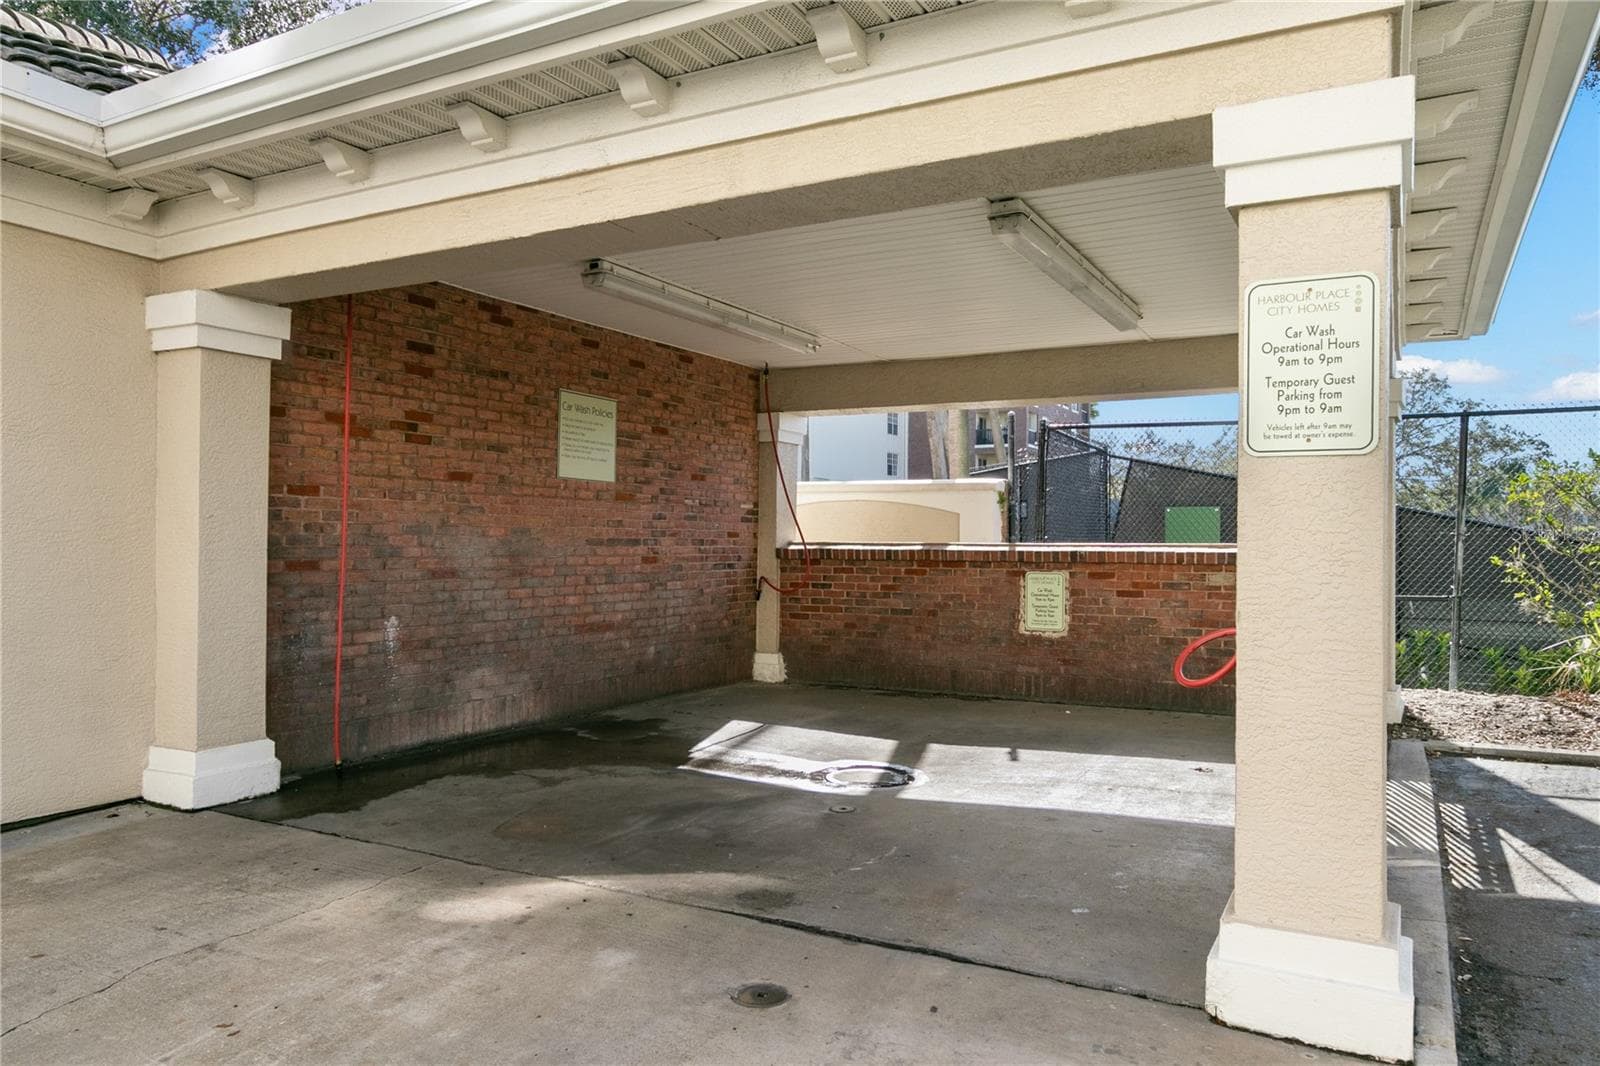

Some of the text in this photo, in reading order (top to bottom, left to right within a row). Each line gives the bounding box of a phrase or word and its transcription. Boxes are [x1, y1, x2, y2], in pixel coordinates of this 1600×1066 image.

[1257, 288, 1350, 305] HARBOUR PLACE
[1266, 301, 1341, 317] CITY HOMES
[1284, 323, 1336, 339] Car Wash
[1261, 337, 1361, 355] Operational Hours
[1277, 353, 1343, 367] 9am to 9pm
[1265, 372, 1356, 389] Temporary Guest
[1277, 387, 1343, 403] Parking from
[562, 401, 614, 419] Car Wash Policies
[1277, 402, 1343, 418] 9pm to 9am
[1266, 421, 1353, 432] Vehicles left after 9am may
[1263, 432, 1273, 440] be
[1273, 431, 1293, 440] towed
